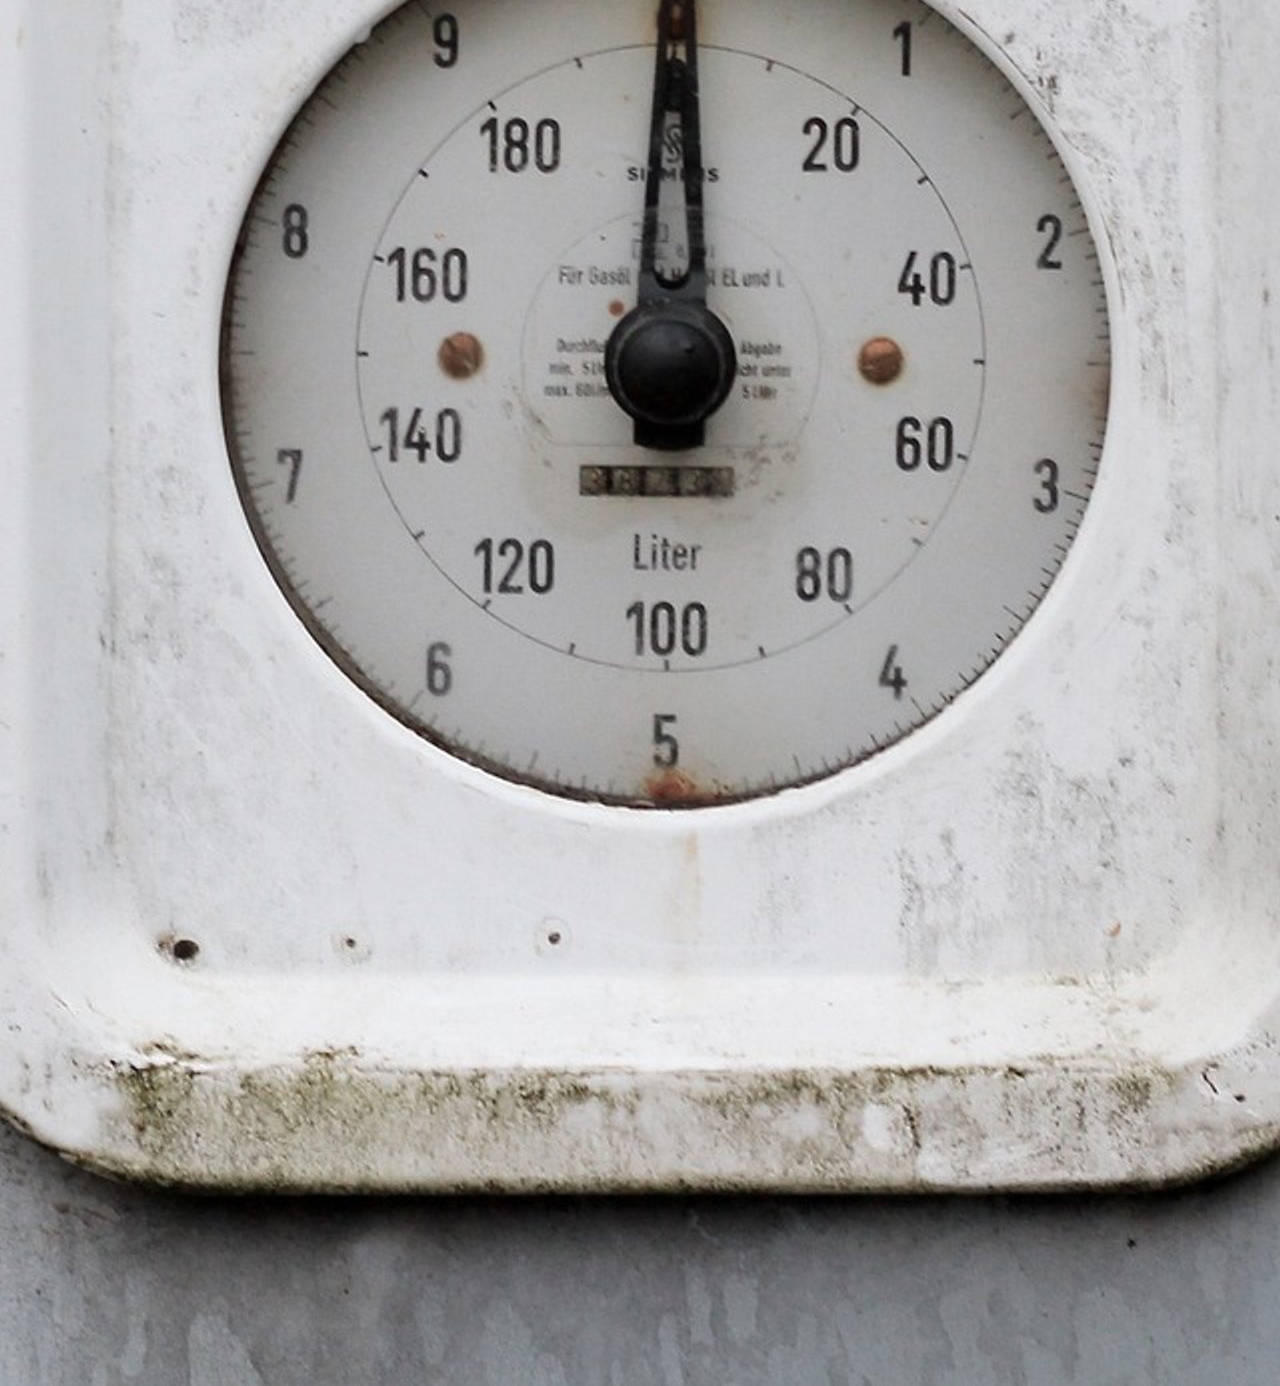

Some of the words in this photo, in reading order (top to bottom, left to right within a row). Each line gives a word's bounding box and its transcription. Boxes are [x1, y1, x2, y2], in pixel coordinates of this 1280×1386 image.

[432, 13, 459, 69] 9
[893, 21, 911, 76] 1
[480, 117, 561, 173] 180
[802, 116, 860, 173] 20
[283, 203, 308, 259] 8
[1037, 214, 1062, 270] 2
[388, 246, 468, 303] 160
[558, 265, 584, 285] Für
[589, 265, 631, 286] Gasöl
[742, 268, 771, 287] und
[898, 251, 956, 307] 40
[381, 408, 461, 463] 140
[896, 417, 953, 471] 60
[277, 449, 302, 504] 7
[1033, 458, 1058, 514] 3
[475, 538, 554, 594] 120
[634, 533, 702, 570] Liter
[796, 547, 852, 602] 80
[626, 601, 708, 656] 100
[426, 642, 452, 696] 6
[879, 644, 907, 699] 4
[653, 714, 679, 769] 5
